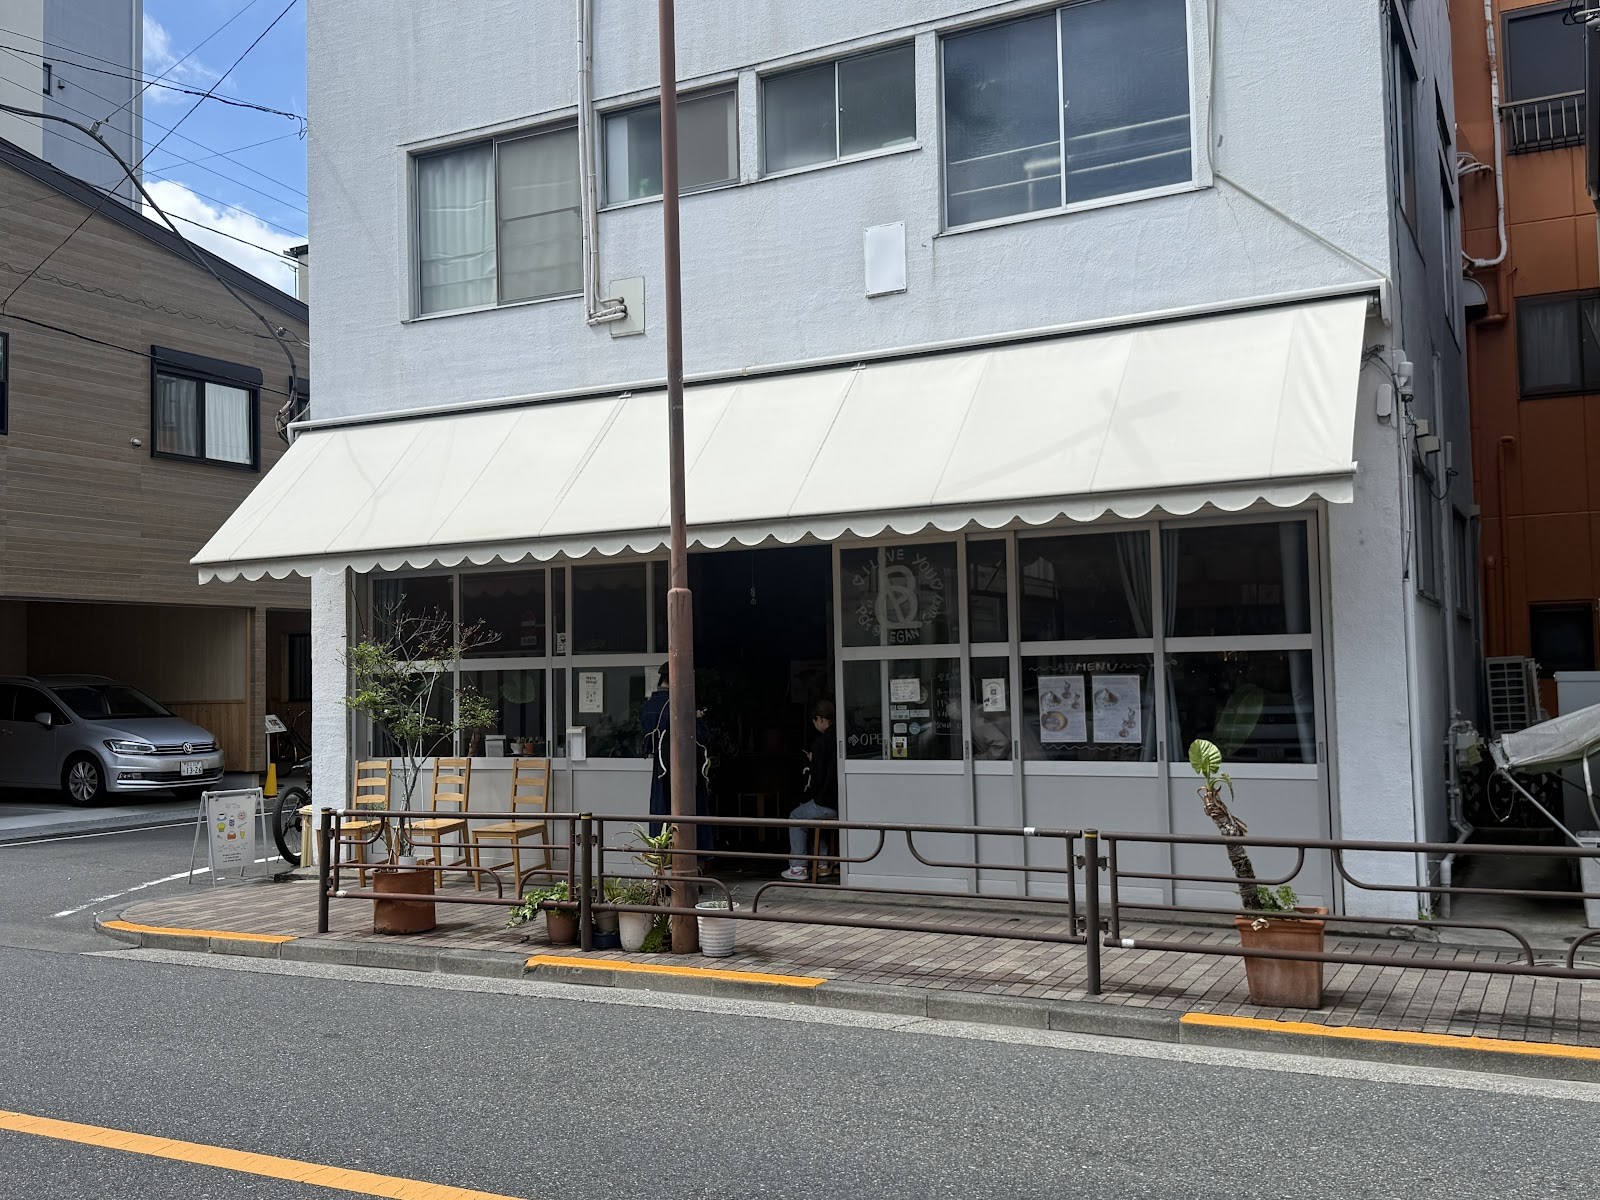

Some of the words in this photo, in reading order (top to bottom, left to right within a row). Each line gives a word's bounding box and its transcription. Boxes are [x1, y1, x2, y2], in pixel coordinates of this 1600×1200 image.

[869, 549, 904, 569] LVE
[911, 553, 938, 580] YOU
[889, 628, 919, 643] EGAN
[1076, 662, 1118, 672] MENU
